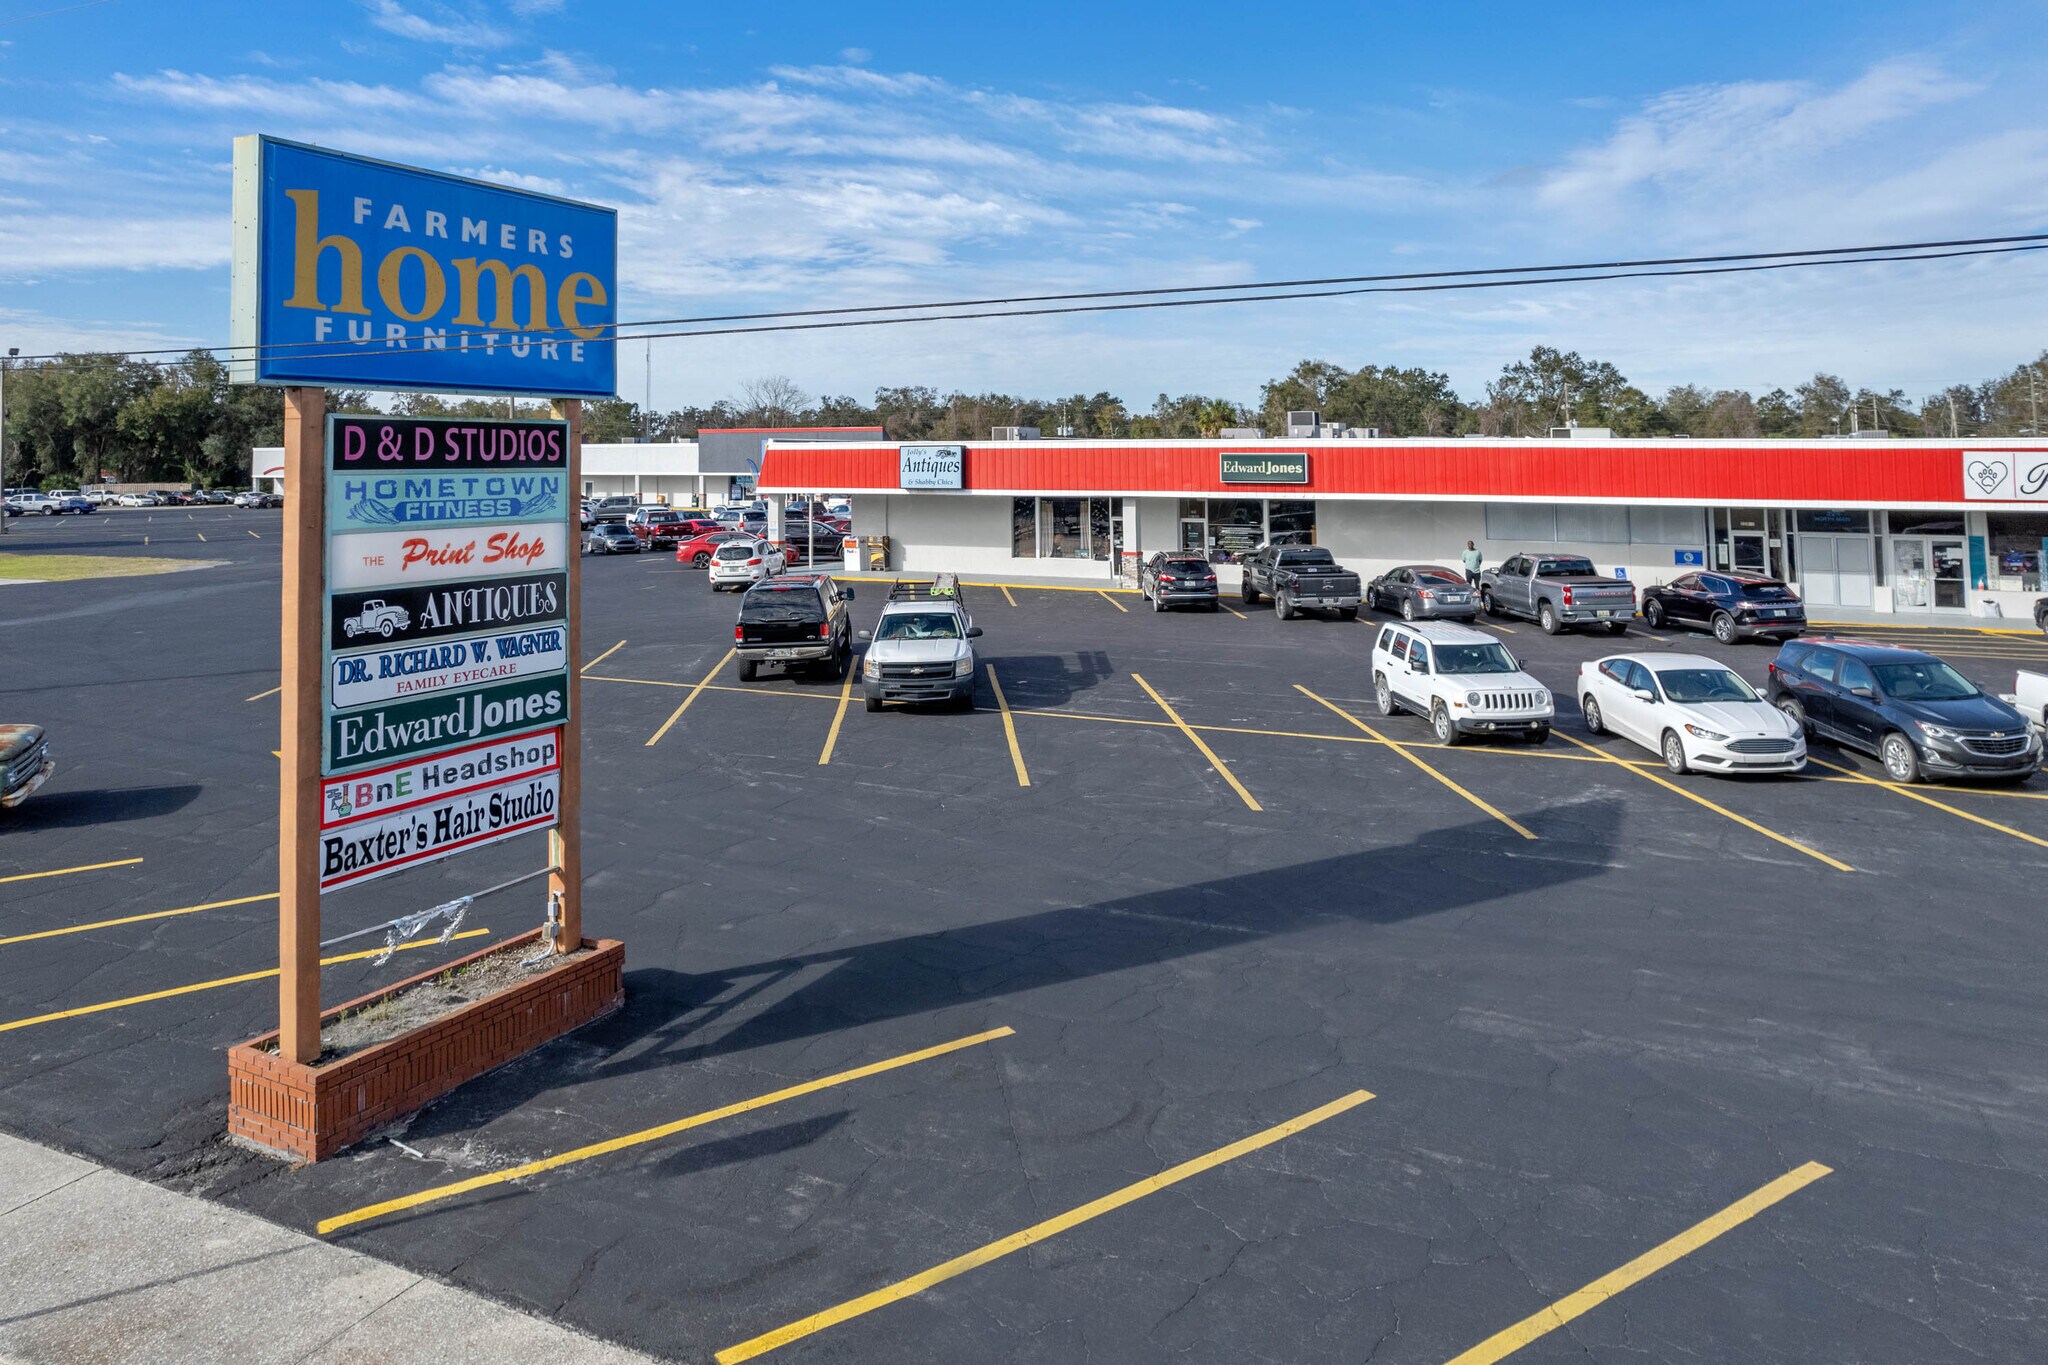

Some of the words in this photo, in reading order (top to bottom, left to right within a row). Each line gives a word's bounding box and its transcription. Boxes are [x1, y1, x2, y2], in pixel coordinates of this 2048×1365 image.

[353, 197, 573, 258] FARMERS
[283, 189, 607, 339] home
[315, 317, 584, 362] FURNITURE
[344, 425, 366, 461] D
[377, 425, 404, 461] &
[415, 427, 435, 461] D
[445, 427, 560, 461] STUDIOS
[345, 477, 559, 500] HOMETOWN
[902, 456, 960, 478] Antiques
[405, 499, 512, 520] FITNESS
[363, 556, 385, 566] THE
[401, 537, 476, 571] Print
[483, 532, 545, 566] Shop
[420, 581, 557, 630] ANTIQUES
[338, 658, 373, 685] DR.
[379, 643, 466, 679] RICHARD
[471, 640, 491, 663] W.
[496, 630, 562, 659] WAGNER
[397, 674, 449, 693] FAMILY
[453, 663, 517, 684] EYECARE
[355, 771, 413, 808] BnE
[422, 743, 555, 790] Headshop
[322, 815, 428, 877] Baxter's
[432, 800, 486, 845] Hair
[488, 781, 554, 829] Studio
